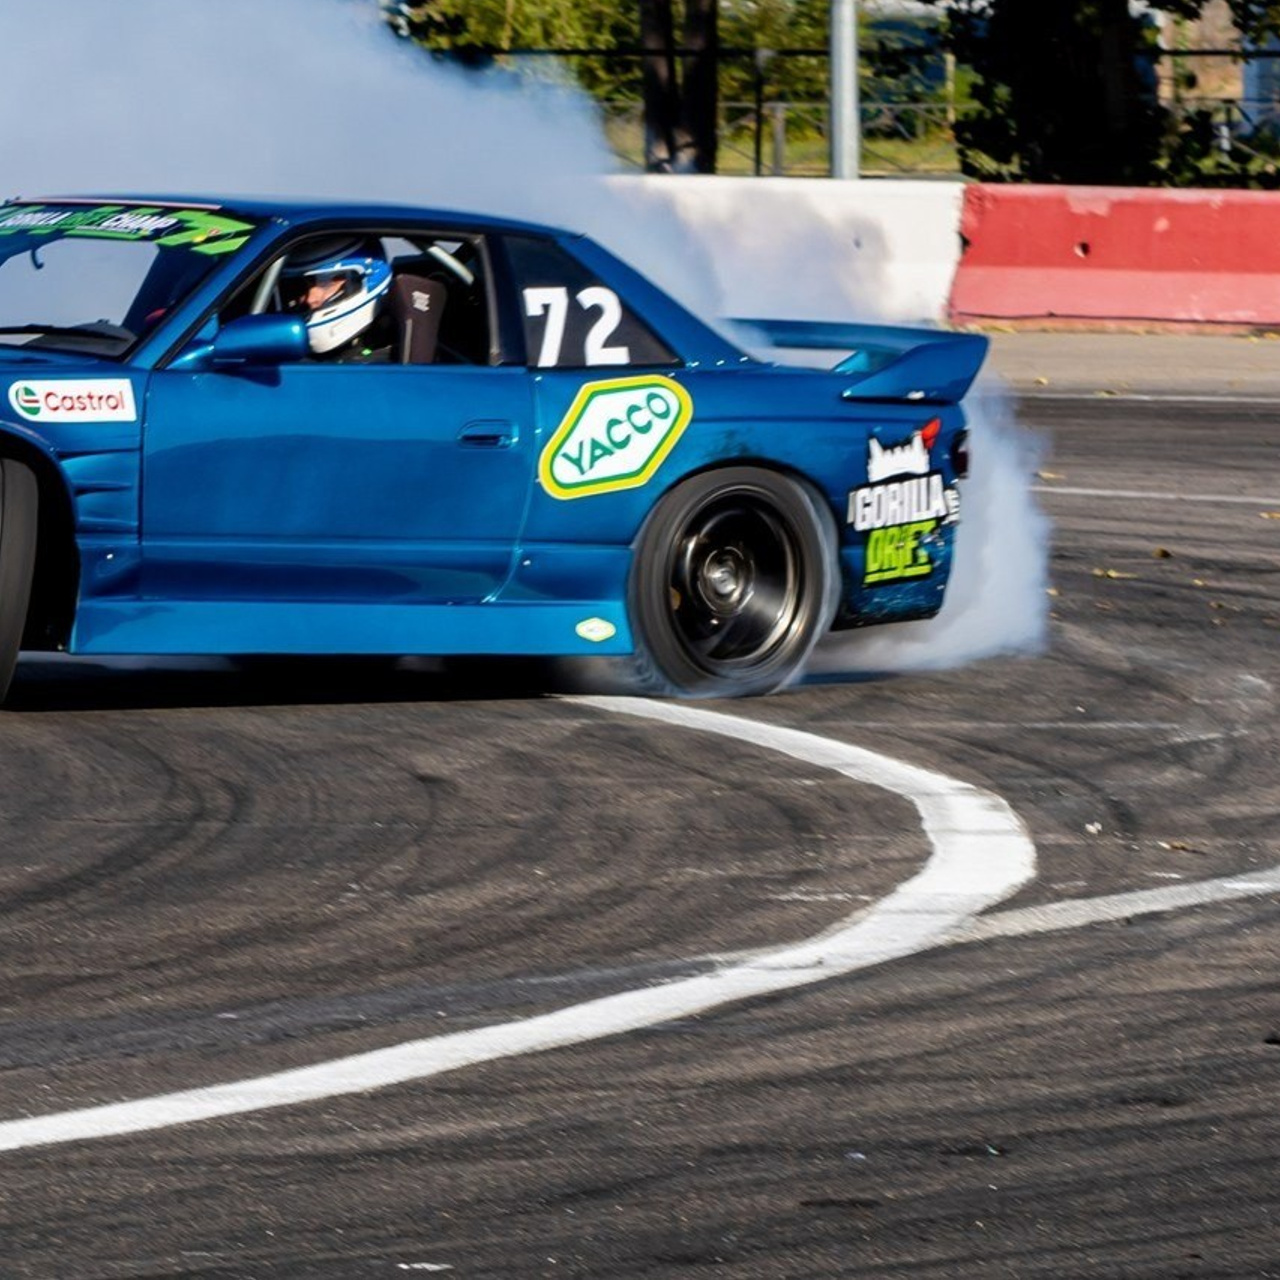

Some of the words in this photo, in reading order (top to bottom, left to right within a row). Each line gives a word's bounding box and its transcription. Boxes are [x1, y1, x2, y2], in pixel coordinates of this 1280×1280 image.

[522, 286, 630, 368] 72
[44, 390, 125, 411] Castrol
[561, 391, 671, 475] YACCO
[853, 474, 947, 532] GORILLA
